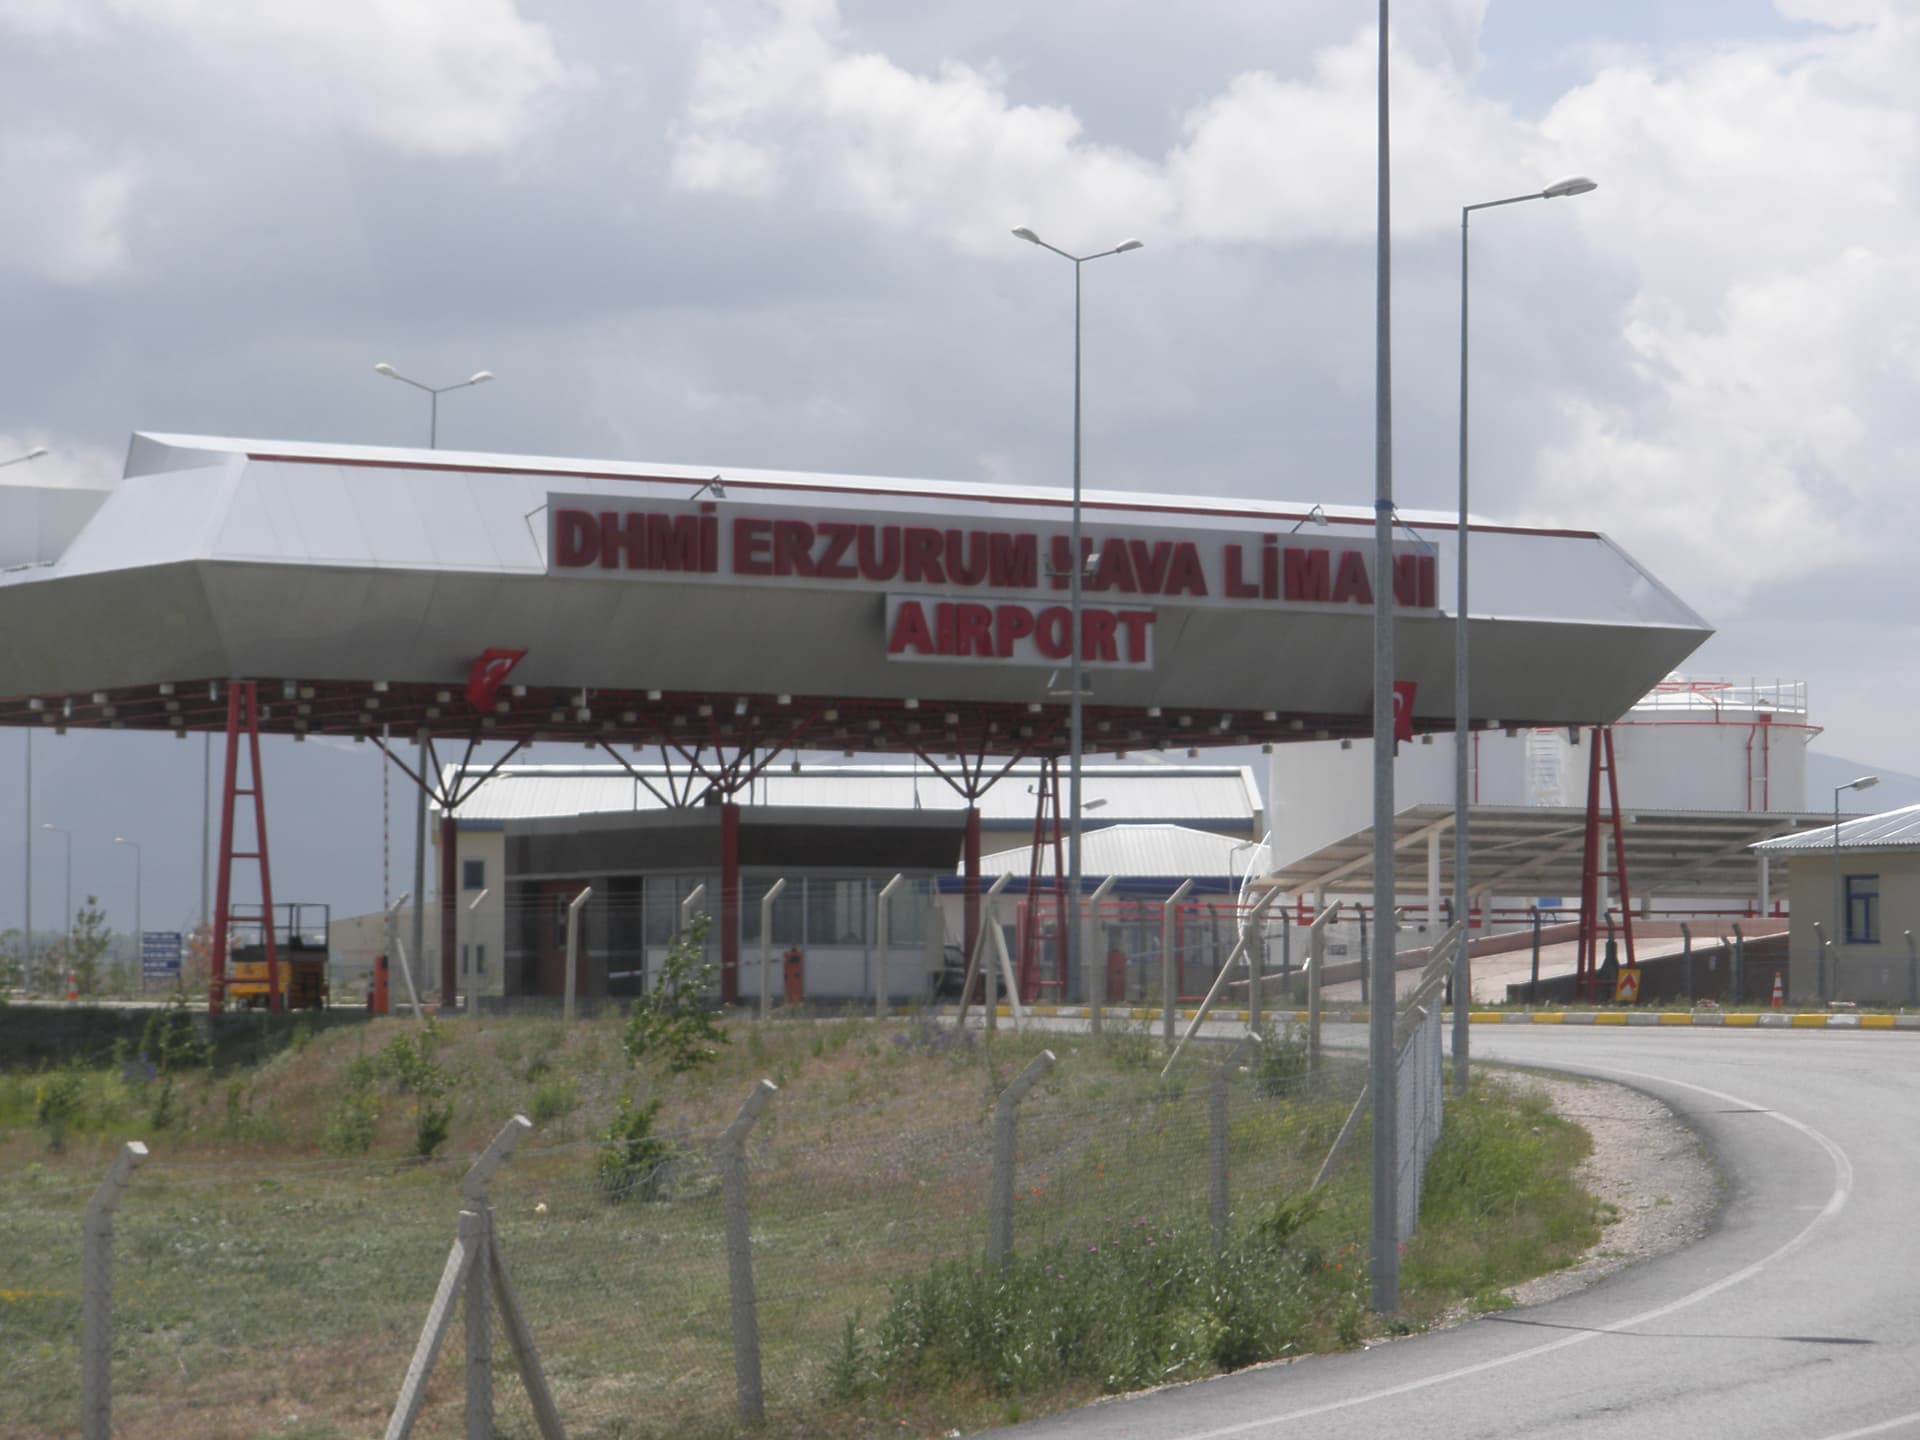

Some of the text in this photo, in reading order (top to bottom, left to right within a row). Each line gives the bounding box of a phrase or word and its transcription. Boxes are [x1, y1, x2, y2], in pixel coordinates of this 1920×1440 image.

[558, 503, 1435, 607] DHMİ ERZURUM HAVA LİMANI
[889, 601, 1156, 662] AIRPORT
